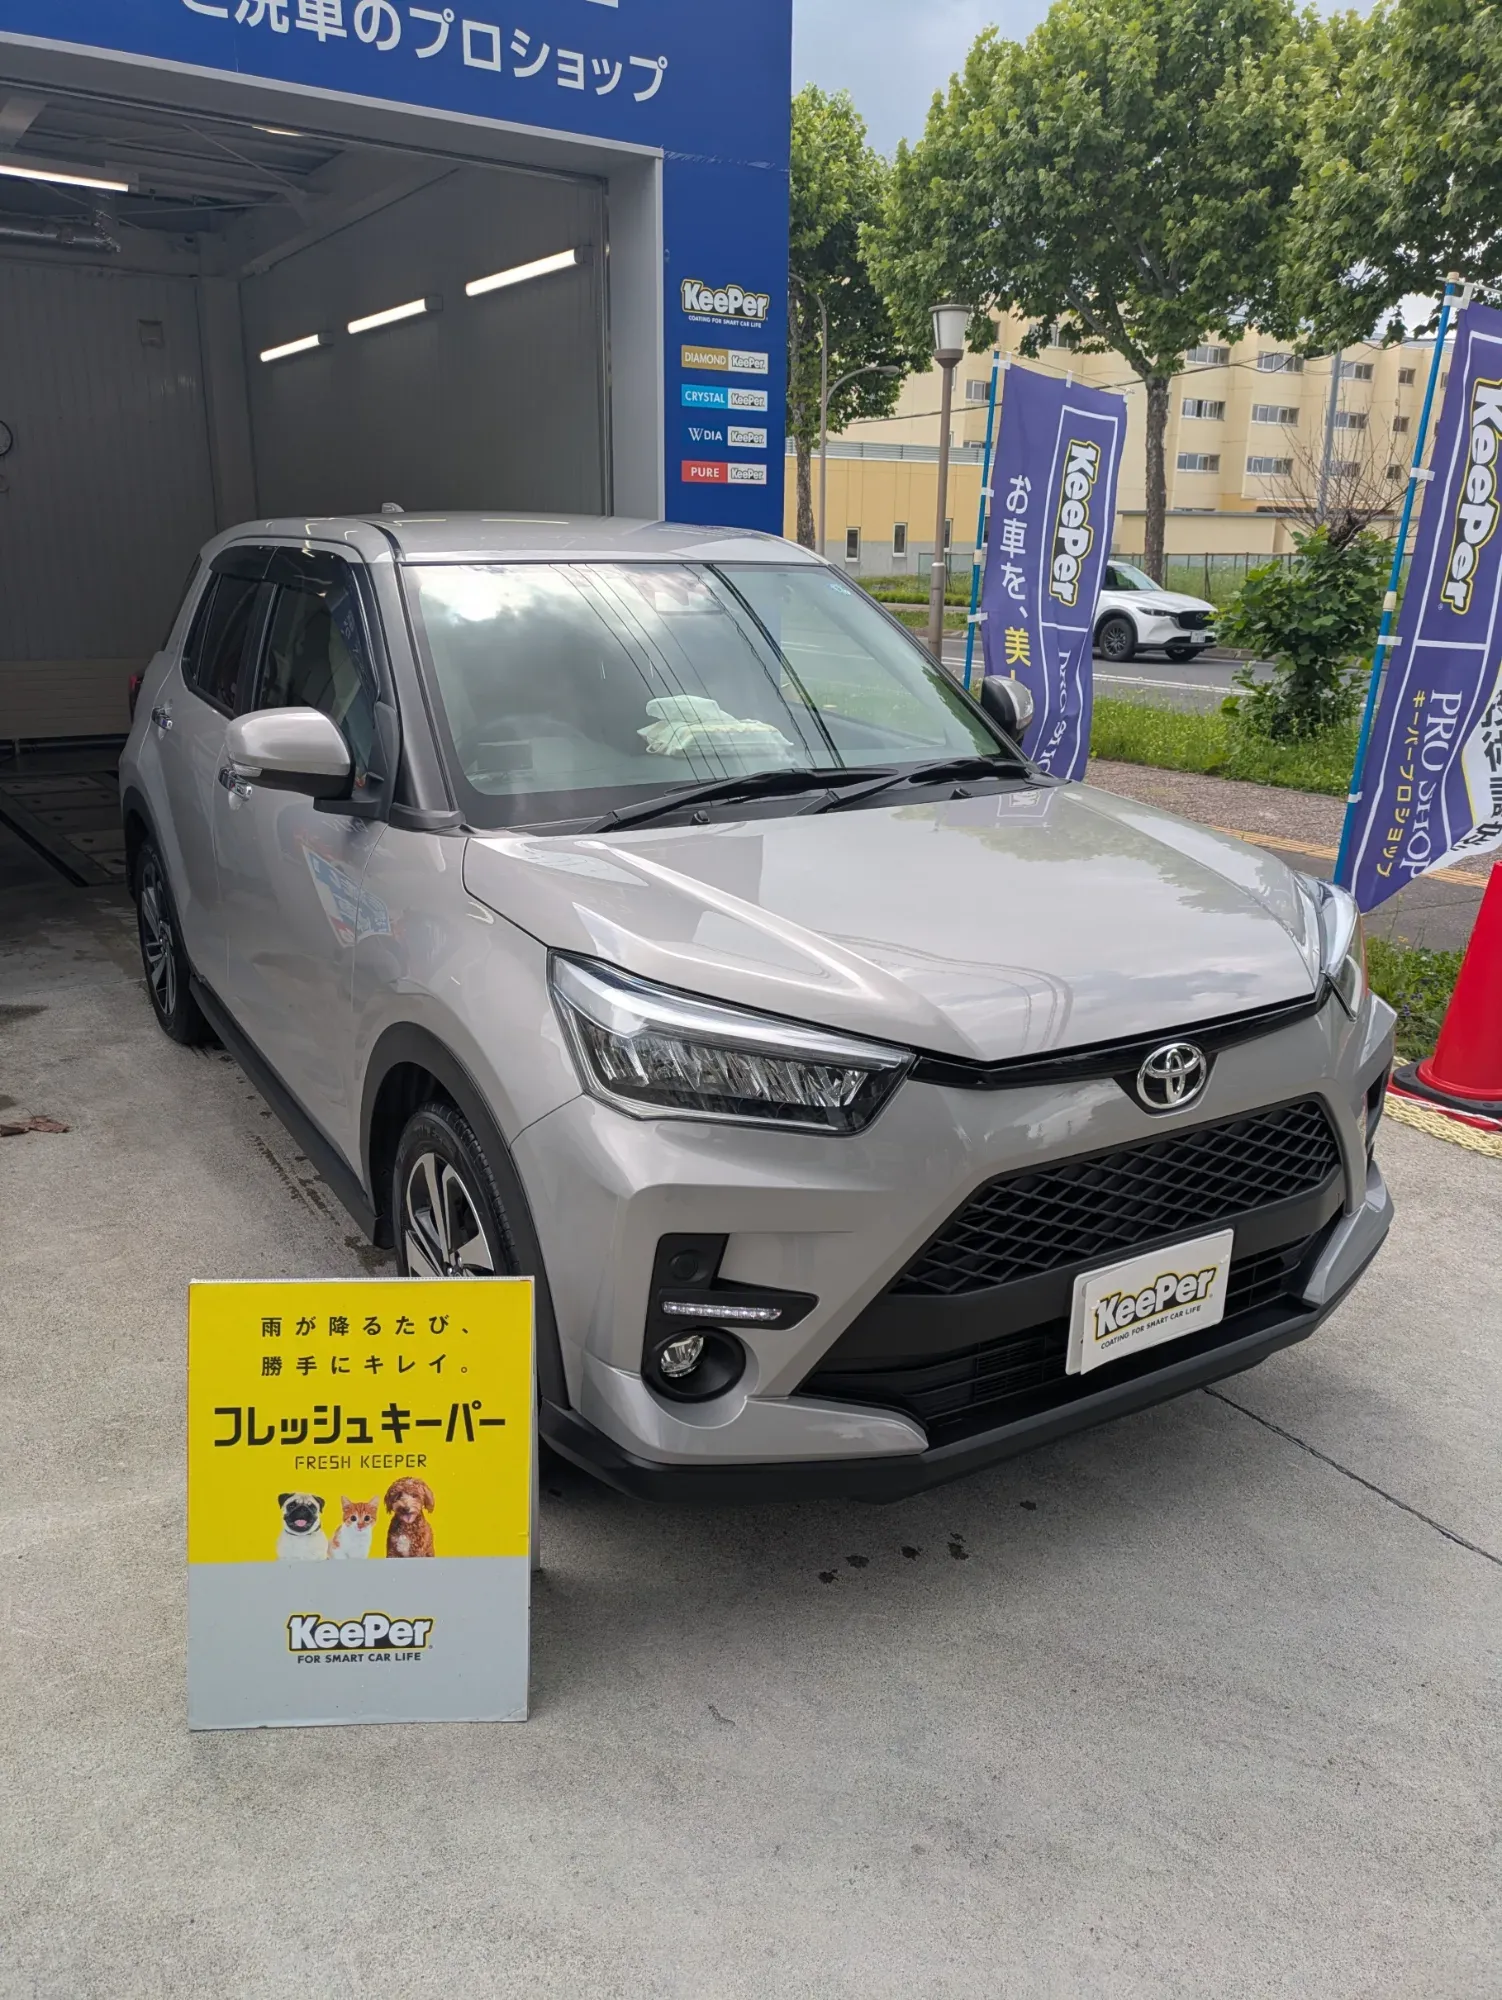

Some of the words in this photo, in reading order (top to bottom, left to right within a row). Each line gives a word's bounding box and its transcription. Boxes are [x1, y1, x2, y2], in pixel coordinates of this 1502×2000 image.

[682, 280, 769, 320] KeePer
[688, 315, 711, 323] COATING
[684, 351, 727, 366] DIAMOND
[731, 355, 766, 370] KeePer
[684, 390, 725, 403] CRYSTAL
[731, 393, 765, 407] KeePer
[730, 430, 765, 444] KeePer
[690, 466, 720, 478] PURE
[730, 468, 764, 480] KeePer
[1049, 440, 1101, 608] KeePer
[1000, 474, 1032, 681] お車を、美
[1376, 689, 1426, 879] キーパープロショップ
[1094, 1266, 1218, 1341] KeePer
[261, 1314, 471, 1338] 雨が降るたび、
[1100, 1331, 1130, 1350] COATING
[1131, 1325, 1145, 1336] FOR
[1146, 1315, 1169, 1330] SMART
[1169, 1310, 1184, 1320] CAR
[1185, 1304, 1202, 1316] LIFE
[261, 1353, 469, 1377] 勝手にキレイ。
[213, 1399, 506, 1447] フレッシュキーパー
[294, 1455, 351, 1470] FRESH
[360, 1453, 428, 1469] KEEPER
[286, 1611, 433, 1652] KeePer
[297, 1655, 321, 1664] FOR
[325, 1653, 364, 1663] SMART
[367, 1653, 391, 1662] CAR
[395, 1652, 422, 1661] LIFE
